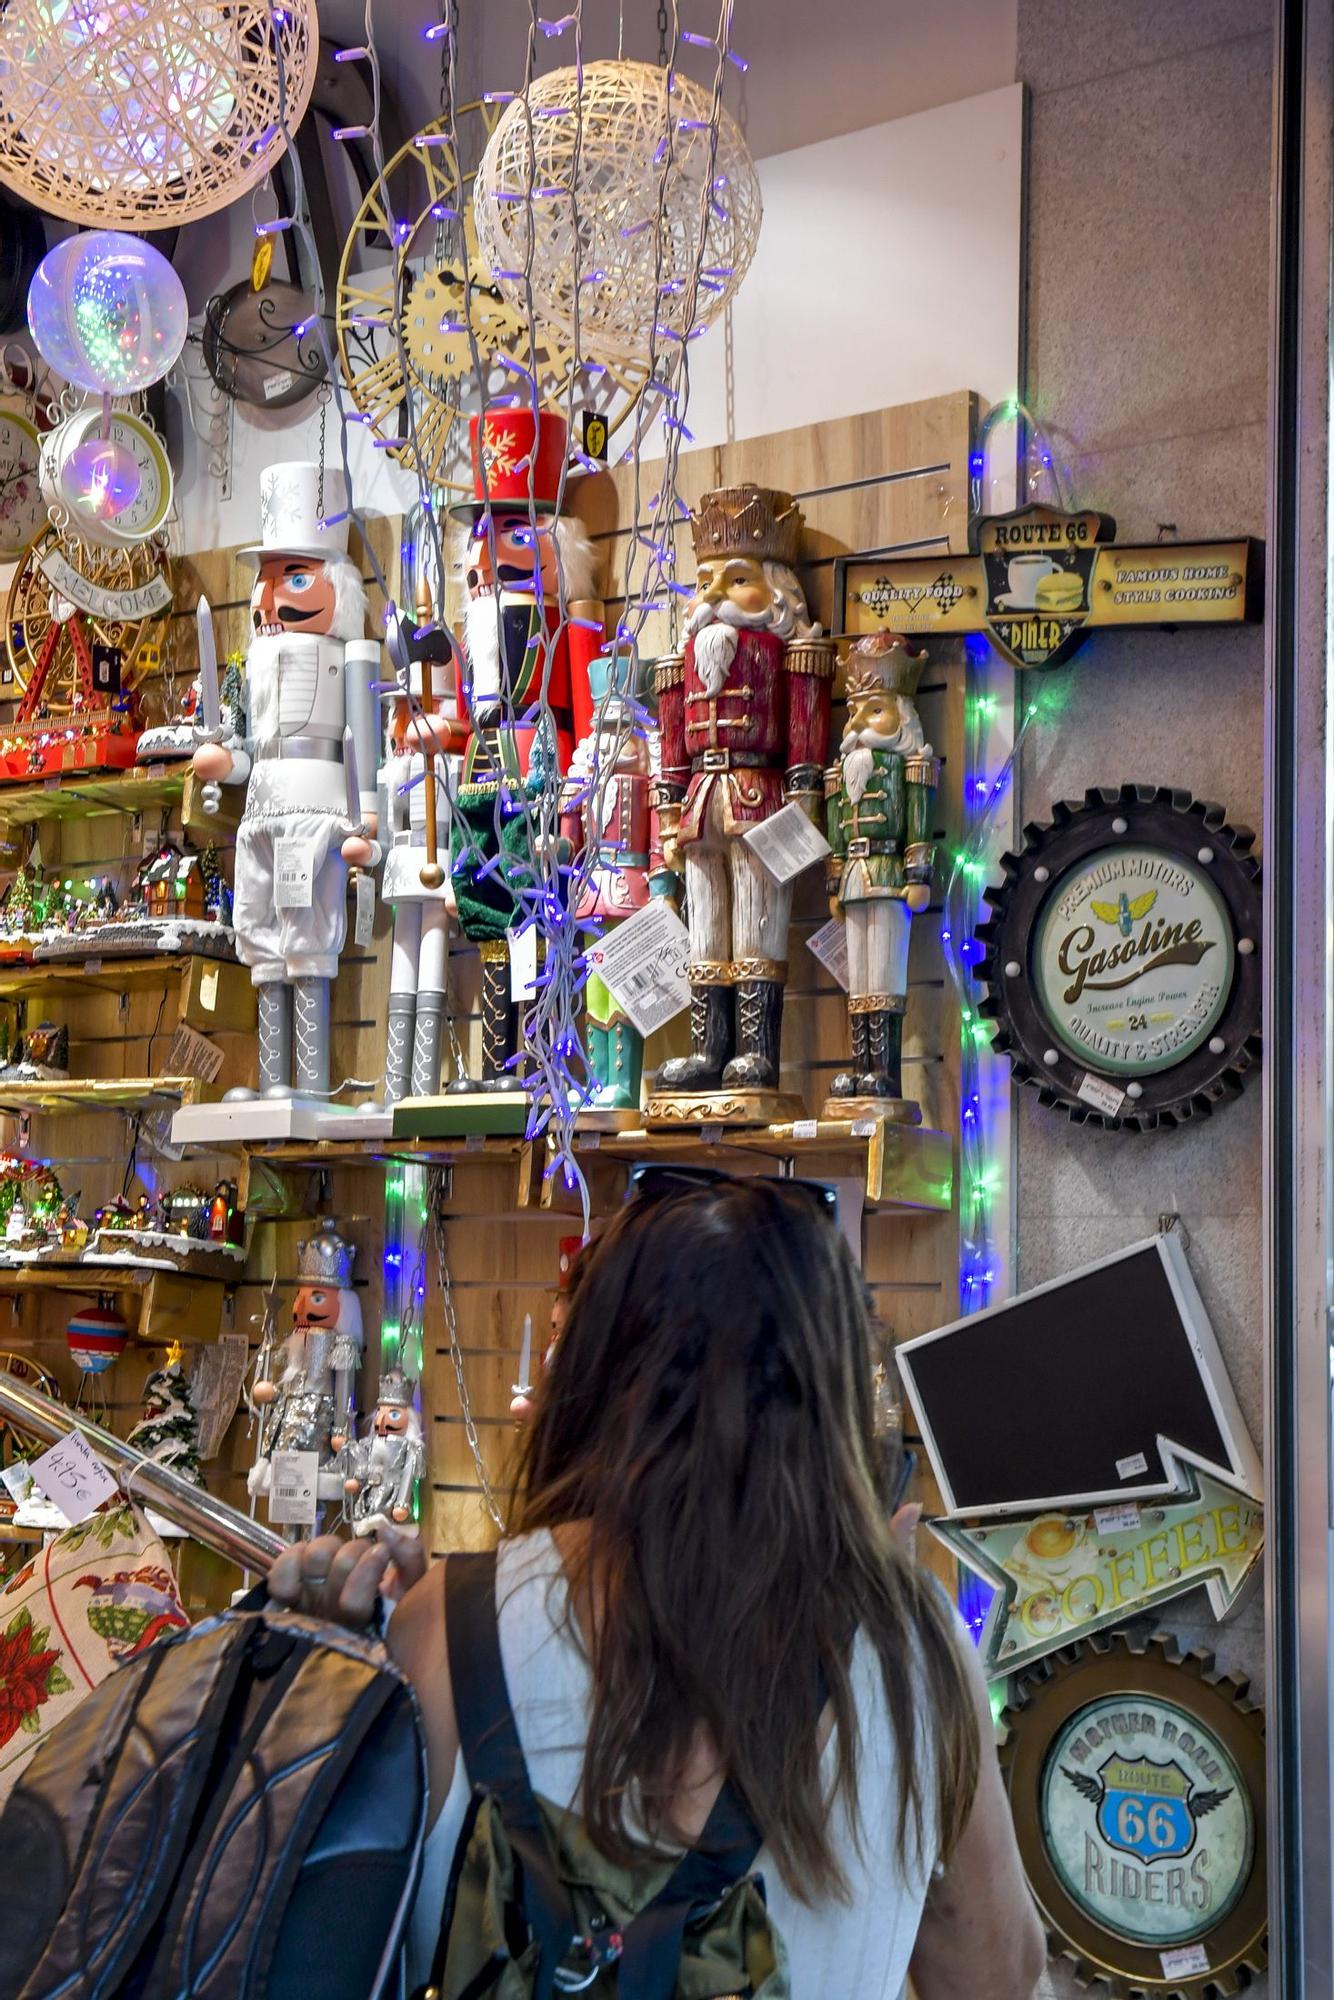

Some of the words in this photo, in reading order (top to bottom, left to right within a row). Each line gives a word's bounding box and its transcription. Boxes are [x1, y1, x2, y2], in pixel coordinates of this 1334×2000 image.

[114, 428, 124, 442] 12
[995, 524, 1061, 544] ROUTE
[1065, 522, 1089, 541] 66
[1116, 567, 1179, 584] FAMOUS
[1182, 565, 1229, 580] HOME
[54, 563, 165, 619] WELCOME
[861, 588, 921, 605] QUALITY
[924, 585, 963, 599] FOOD
[1114, 589, 1162, 605] STYLE
[1164, 586, 1237, 601] COOKING
[1011, 621, 1061, 651] DINER
[1058, 859, 1126, 922] PREMIUM
[1125, 858, 1195, 898] MOTORS
[1058, 917, 1203, 1004] Gasoline
[1126, 995, 1155, 1008] Engine
[1068, 1013, 1131, 1061] QUALITY
[1129, 1013, 1148, 1031] 24
[1020, 1503, 1249, 1638] COFFEE
[1069, 1712, 1157, 1764] MOTHER
[1161, 1720, 1223, 1784] ROAD
[1118, 1768, 1171, 1788] ROUTE
[1117, 1798, 1177, 1849] 66
[1084, 1830, 1214, 1910] RIDERS
